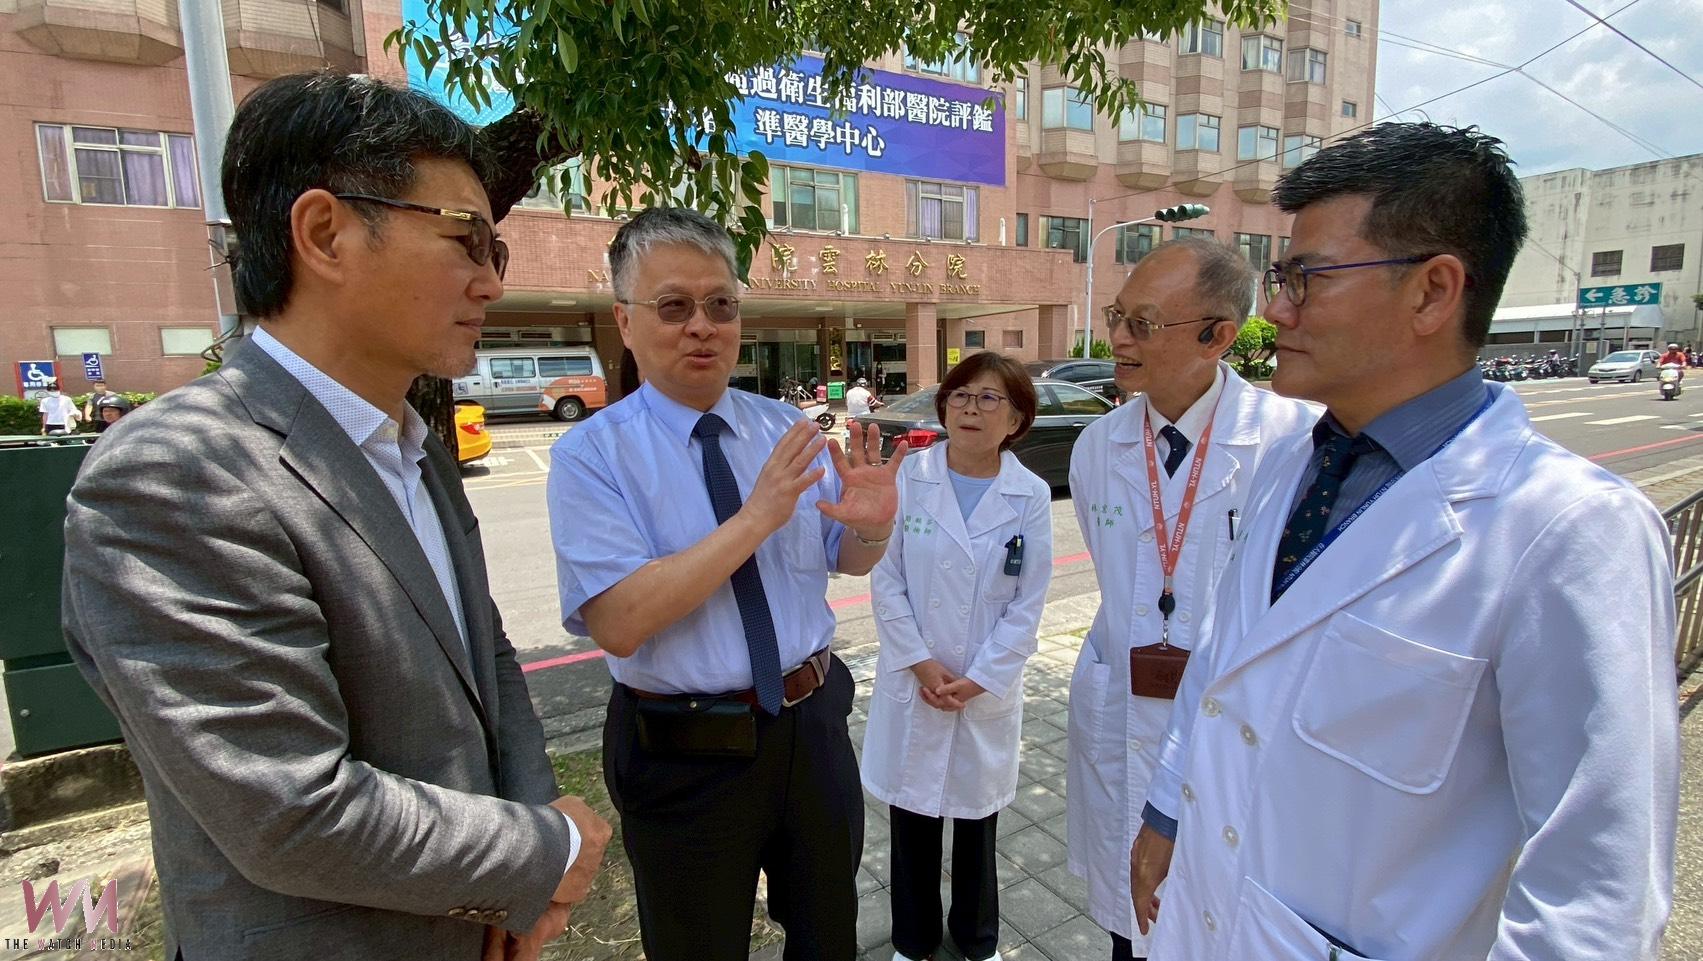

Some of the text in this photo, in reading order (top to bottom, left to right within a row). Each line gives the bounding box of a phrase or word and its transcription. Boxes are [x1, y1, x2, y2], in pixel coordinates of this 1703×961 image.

[755, 108, 885, 157] 準醫學中心
[826, 279, 883, 294] HOSPITAL
[890, 282, 935, 296] YUN-LIN
[939, 284, 981, 296] BRANCH
[1608, 285, 1657, 304] 急診
[1189, 457, 1202, 487] NTUH-YL
[1151, 481, 1161, 510] NTUH-YL
[1172, 522, 1185, 552] NTUH-YL
